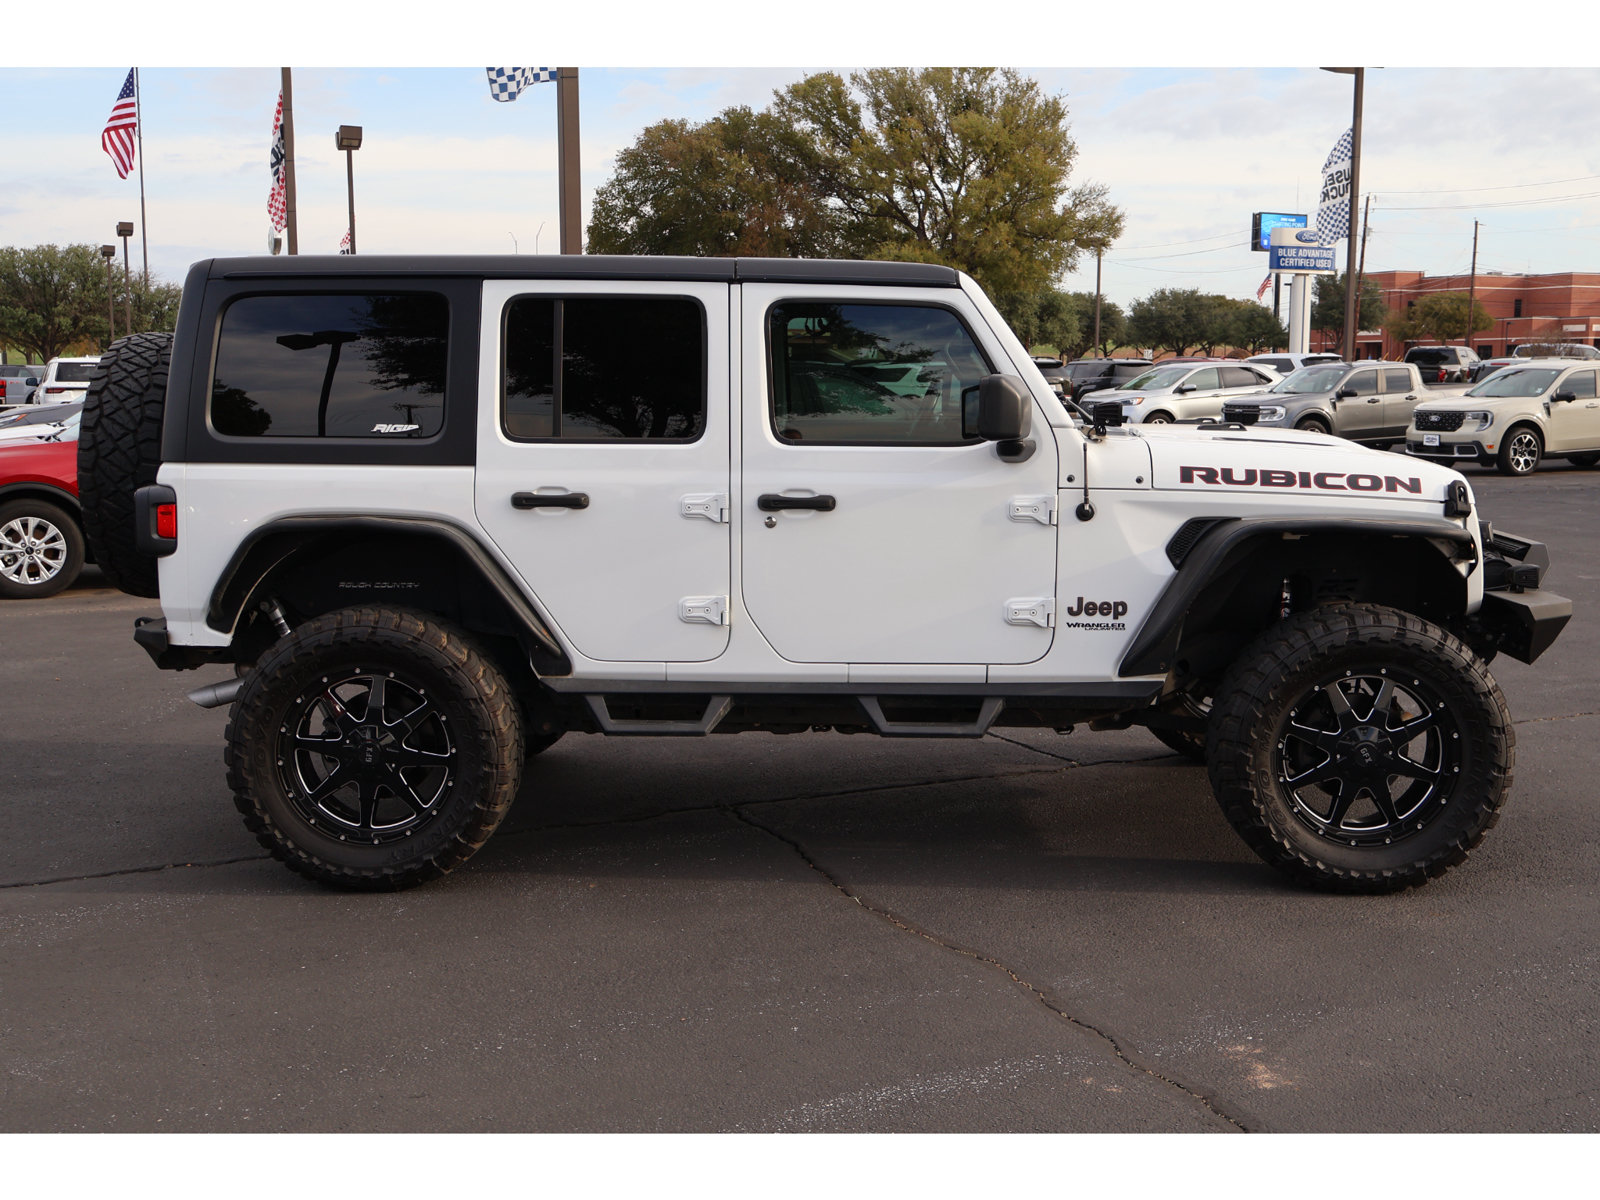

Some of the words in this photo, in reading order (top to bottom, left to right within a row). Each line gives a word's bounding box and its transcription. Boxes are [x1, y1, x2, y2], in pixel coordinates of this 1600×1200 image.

[1278, 248, 1297, 257] BLUE
[1297, 248, 1334, 259] ADVANTAGE
[1280, 258, 1315, 267] CERTIFIED
[1315, 259, 1332, 268] USED
[1180, 466, 1422, 494] RUBICON
[338, 581, 372, 589] ROUGH
[373, 581, 420, 589] COUNTRY
[1067, 596, 1128, 620] Jeep
[1360, 747, 1373, 764] GFX
